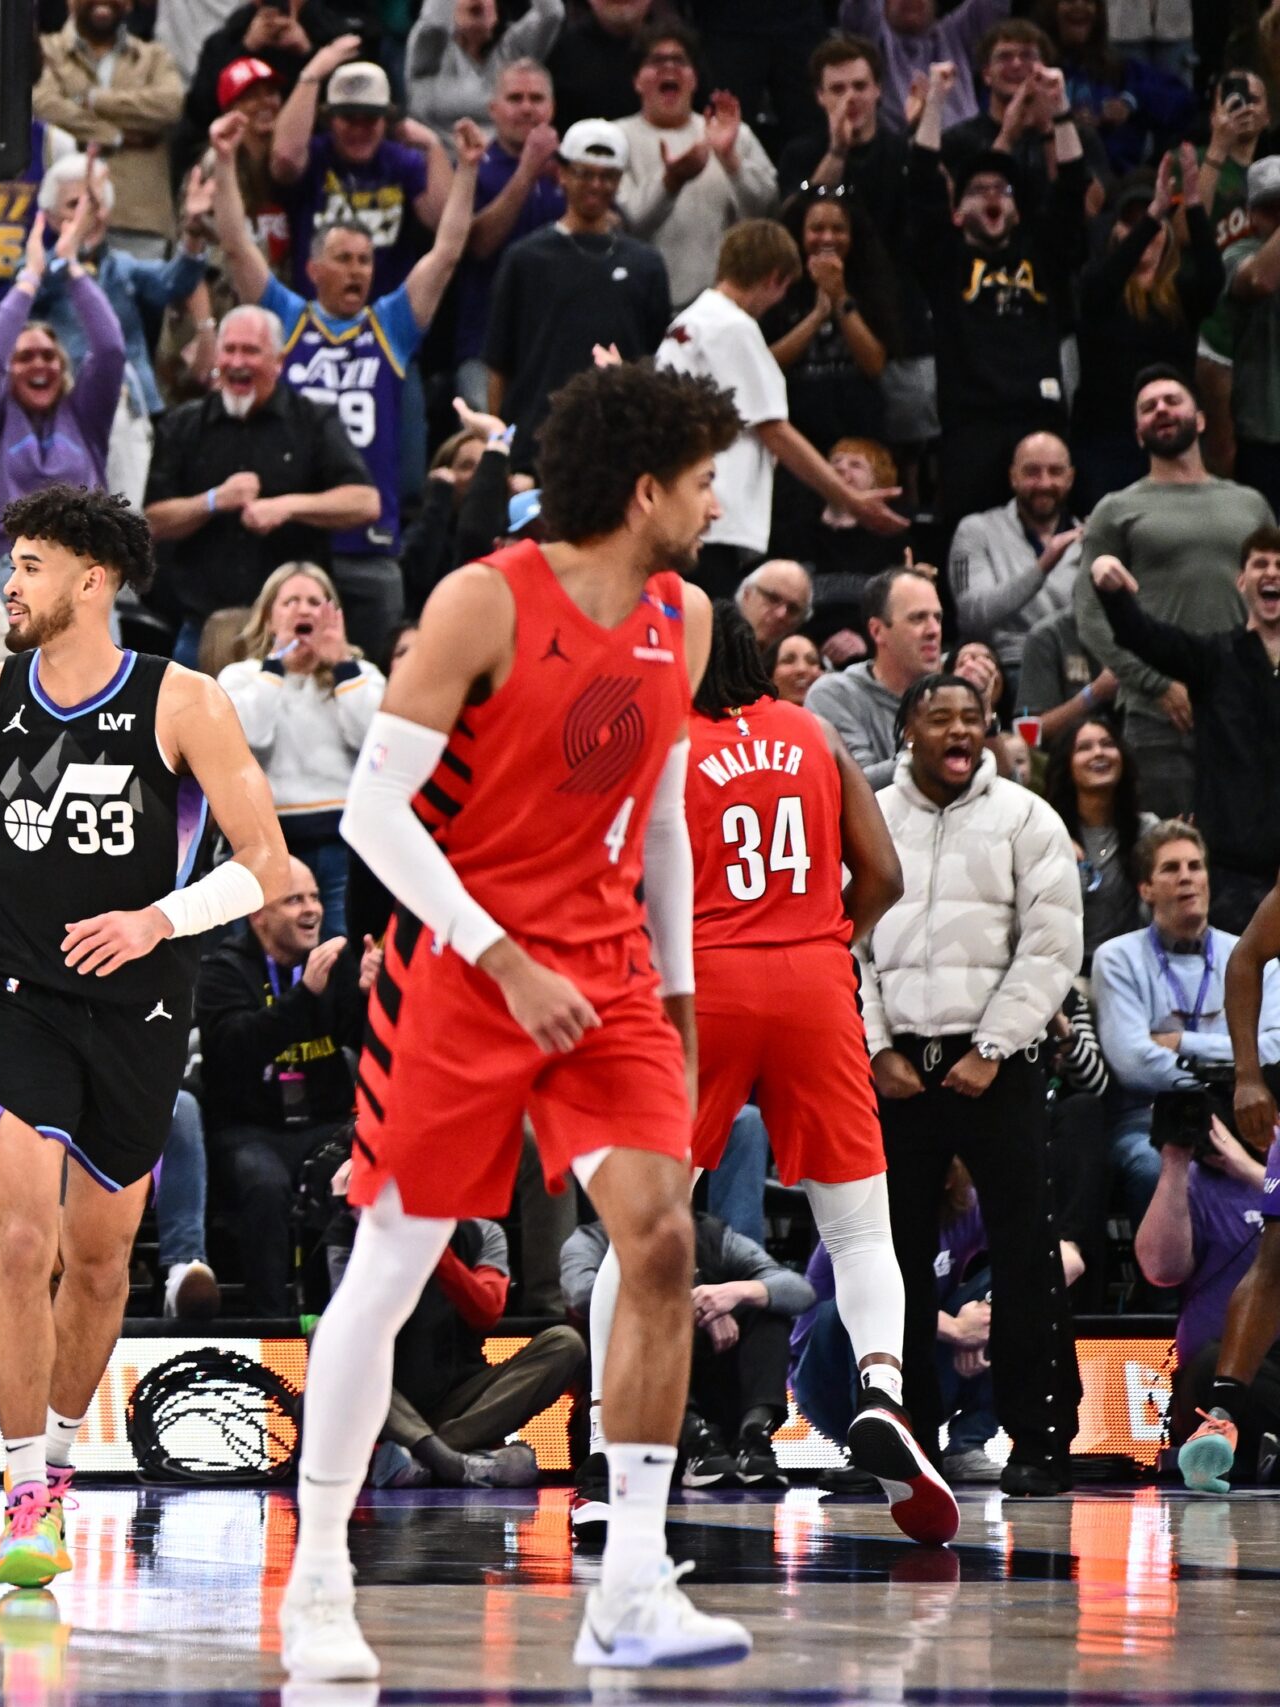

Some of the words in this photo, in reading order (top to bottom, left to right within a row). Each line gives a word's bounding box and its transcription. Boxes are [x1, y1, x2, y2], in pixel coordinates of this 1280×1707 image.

[98, 712, 136, 731] LVT
[698, 739, 803, 787] WALKER
[66, 799, 135, 856] 33
[604, 796, 635, 864] 4
[721, 795, 811, 902] 34
